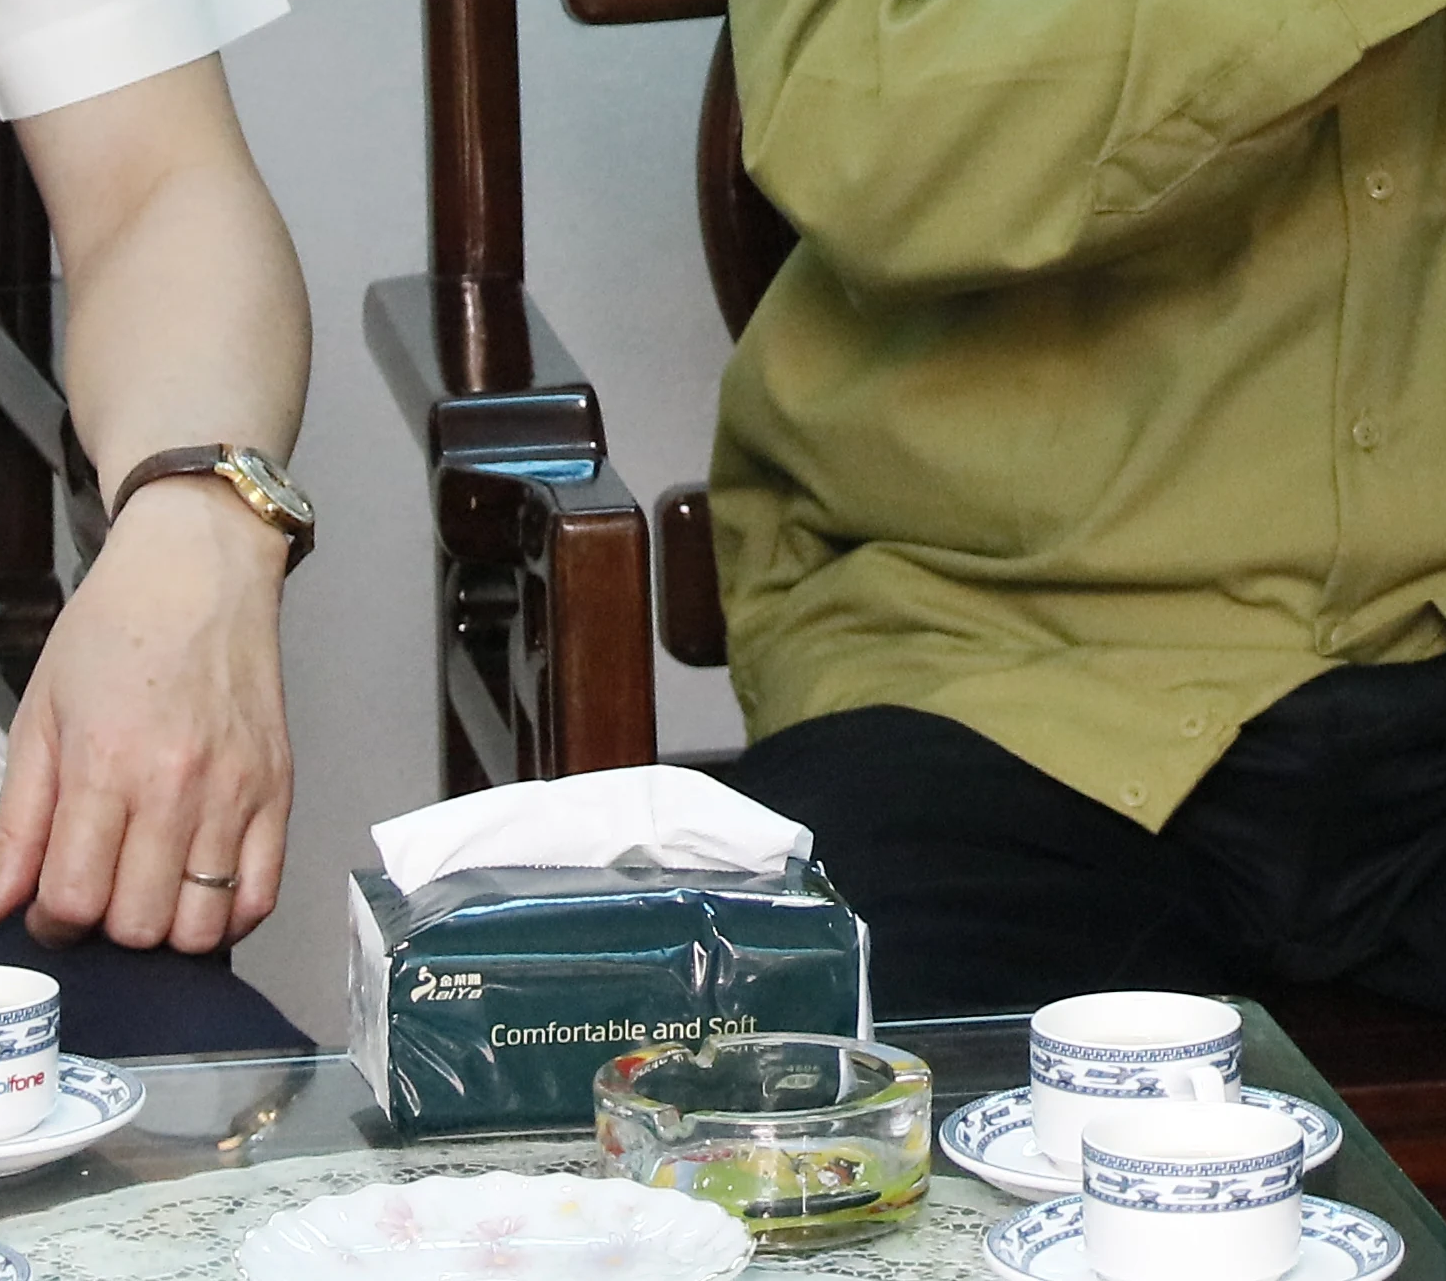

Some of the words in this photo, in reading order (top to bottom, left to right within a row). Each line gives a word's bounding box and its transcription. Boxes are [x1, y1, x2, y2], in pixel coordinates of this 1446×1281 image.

[491, 1019, 646, 1047] Comfortable
[653, 1017, 701, 1040] and
[708, 1014, 758, 1036] Soft
